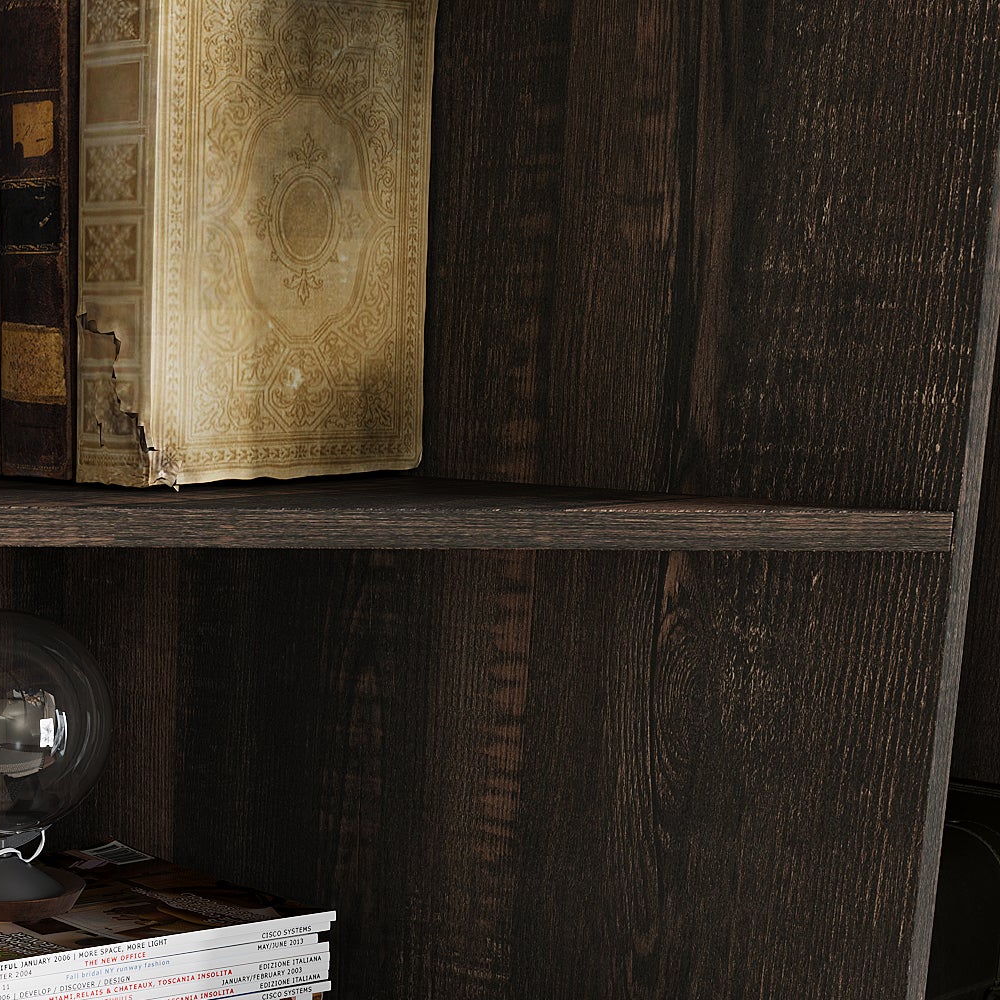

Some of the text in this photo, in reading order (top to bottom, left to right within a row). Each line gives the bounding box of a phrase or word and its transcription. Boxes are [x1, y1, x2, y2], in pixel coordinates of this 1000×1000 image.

[261, 925, 312, 939] CISCO SYSTEMS
[257, 938, 304, 951] MAY/JUNE 2013
[21, 958, 51, 968] JANUARY
[54, 953, 71, 962] 2006
[78, 948, 97, 958] MORE
[100, 946, 124, 956] SPACE,
[127, 942, 145, 951] MORE
[147, 939, 168, 947] LIGHT
[101, 955, 117, 964] NEW
[120, 952, 146, 961] OFFICE
[82, 970, 102, 978] bridal
[116, 965, 142, 974] runway
[144, 959, 170, 969] fashion
[259, 955, 322, 971] EDIZIONE ITALIANA
[15, 969, 32, 978] 2004
[158, 974, 195, 986] TOSCANIA
[197, 969, 233, 980] INSOLITA
[221, 967, 303, 986] JANUARY/FEBRUARY 2003
[259, 973, 321, 989] EDIZIONE ITALIANA
[19, 988, 51, 998] DEVELOP
[60, 981, 95, 992] DISCOVER
[104, 976, 131, 985] DESIGN
[200, 988, 235, 999] INSOLITA
[261, 986, 312, 1000] CISCO SYSTEMS
